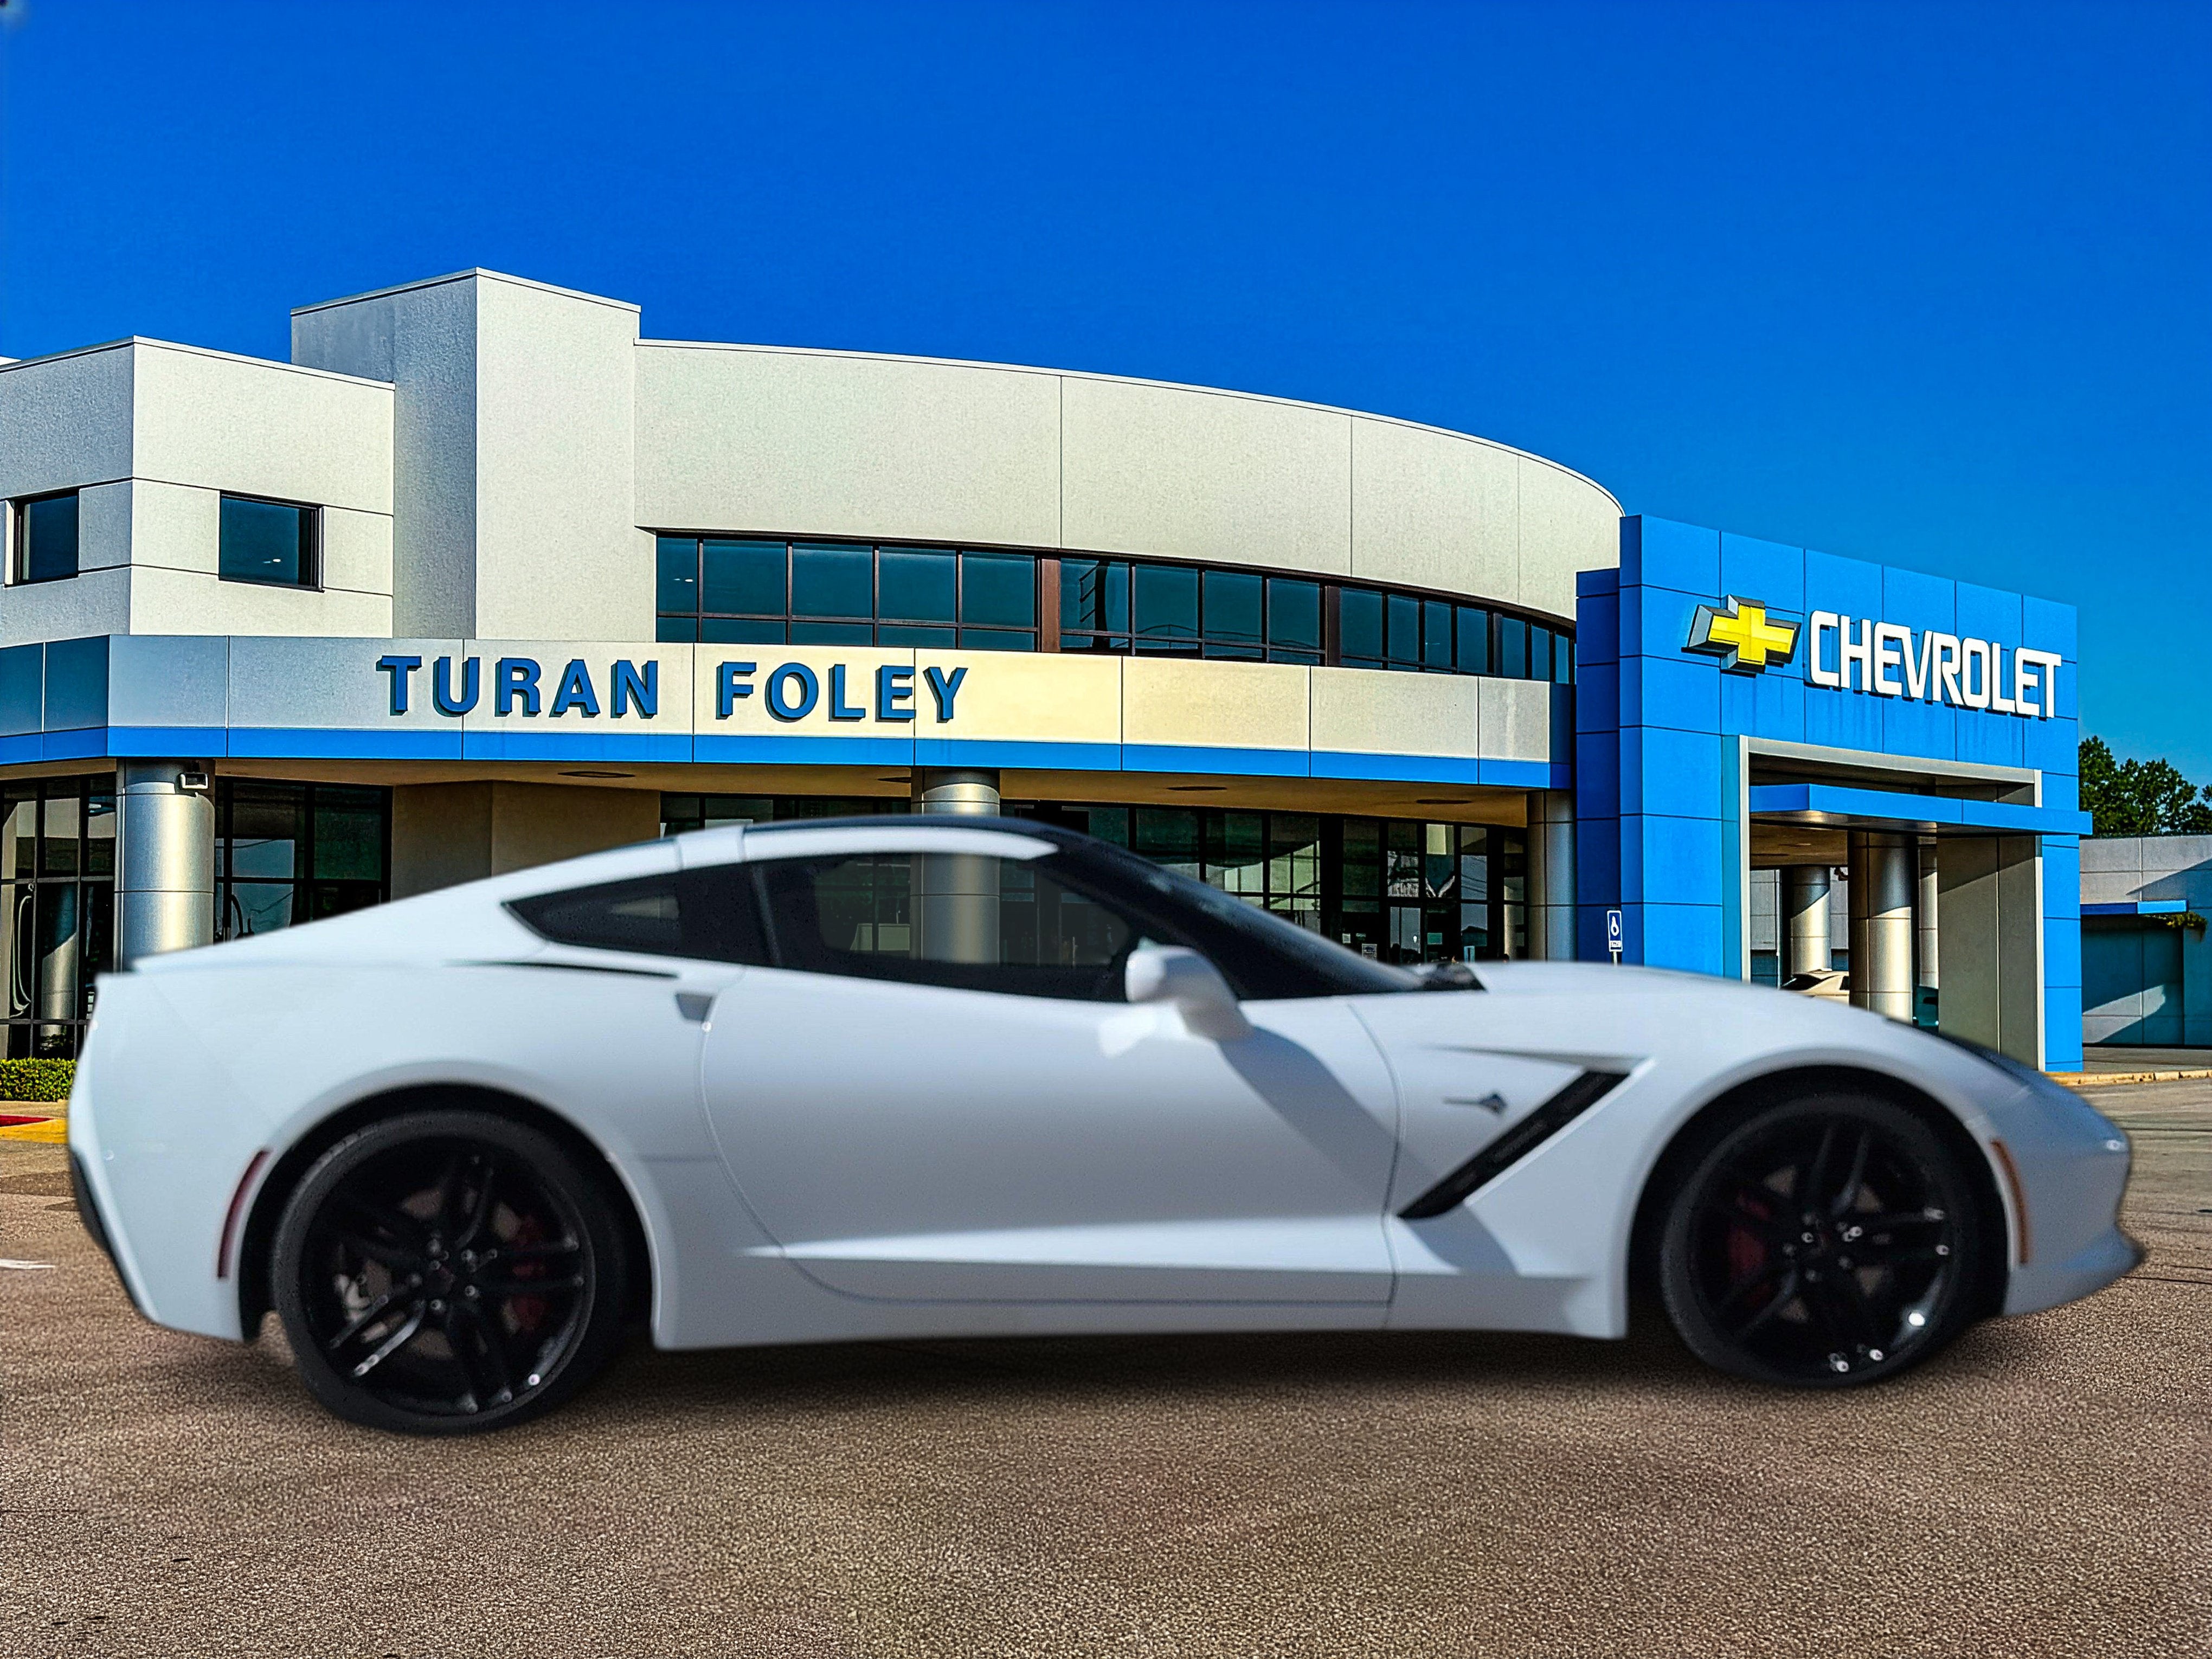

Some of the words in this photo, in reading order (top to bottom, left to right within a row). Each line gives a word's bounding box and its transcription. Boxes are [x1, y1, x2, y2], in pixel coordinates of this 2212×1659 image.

[375, 655, 658, 719] TURAN
[716, 661, 968, 723] FOLEY
[1810, 610, 2062, 719] CHEVROLET
